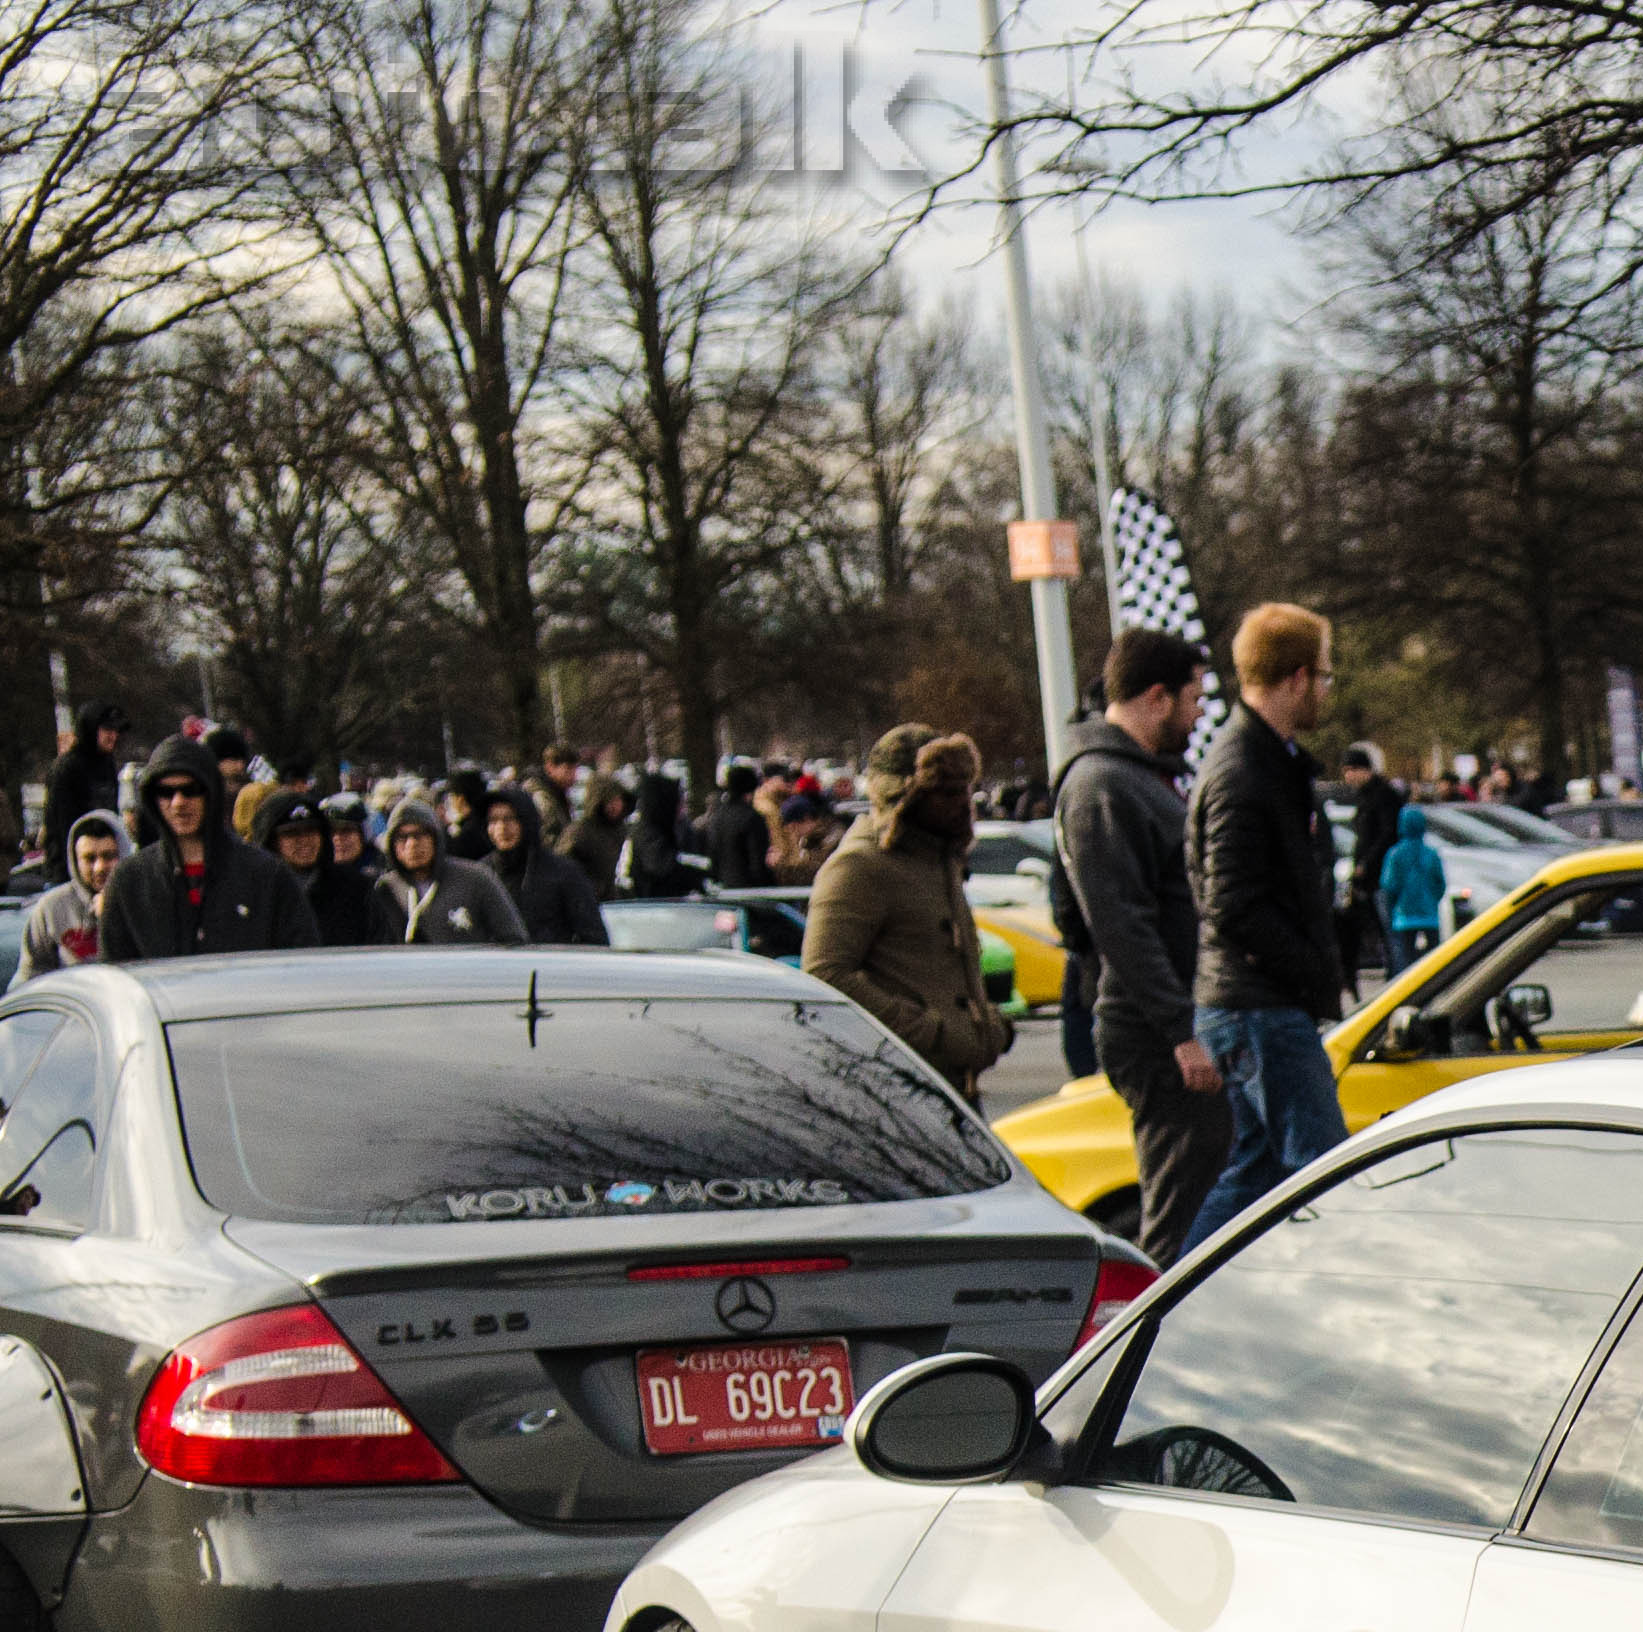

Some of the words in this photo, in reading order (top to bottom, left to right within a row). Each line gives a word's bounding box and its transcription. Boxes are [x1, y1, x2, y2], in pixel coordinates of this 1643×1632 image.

[446, 1183, 596, 1217] KORU
[664, 1177, 848, 1202] WORKS
[377, 1318, 456, 1345] CLK
[689, 1347, 802, 1371] GEORGIA
[649, 1375, 699, 1427] DL
[726, 1366, 845, 1422] 69C23
